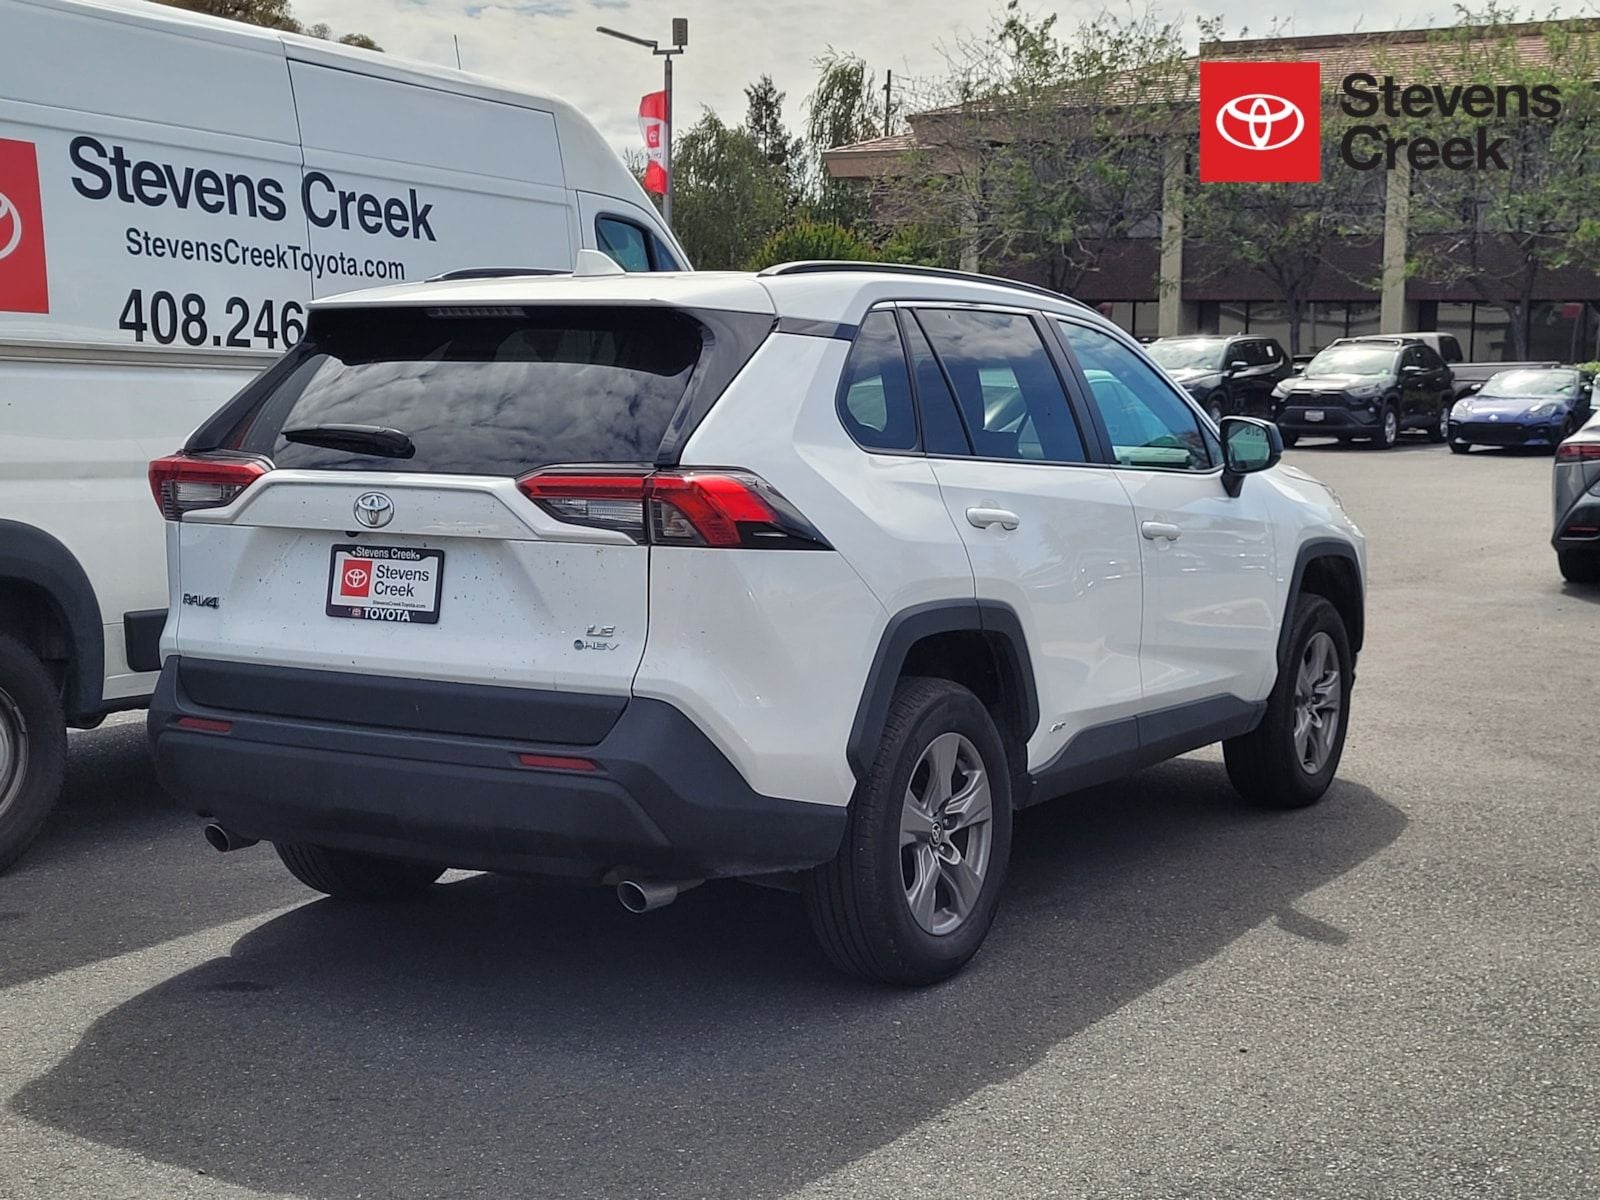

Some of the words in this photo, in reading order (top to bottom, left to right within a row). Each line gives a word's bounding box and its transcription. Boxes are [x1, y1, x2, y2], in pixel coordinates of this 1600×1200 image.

[69, 136, 287, 221] Stevens
[302, 172, 437, 241] Creek
[126, 227, 405, 280] StevensCreekToyota.com
[356, 547, 390, 558] Stevens
[391, 548, 416, 560] Creek
[376, 564, 430, 582] Stevens
[374, 581, 414, 597] Creek
[183, 593, 220, 609] RAV4
[364, 607, 411, 622] TOYOTA
[586, 624, 616, 637] LE
